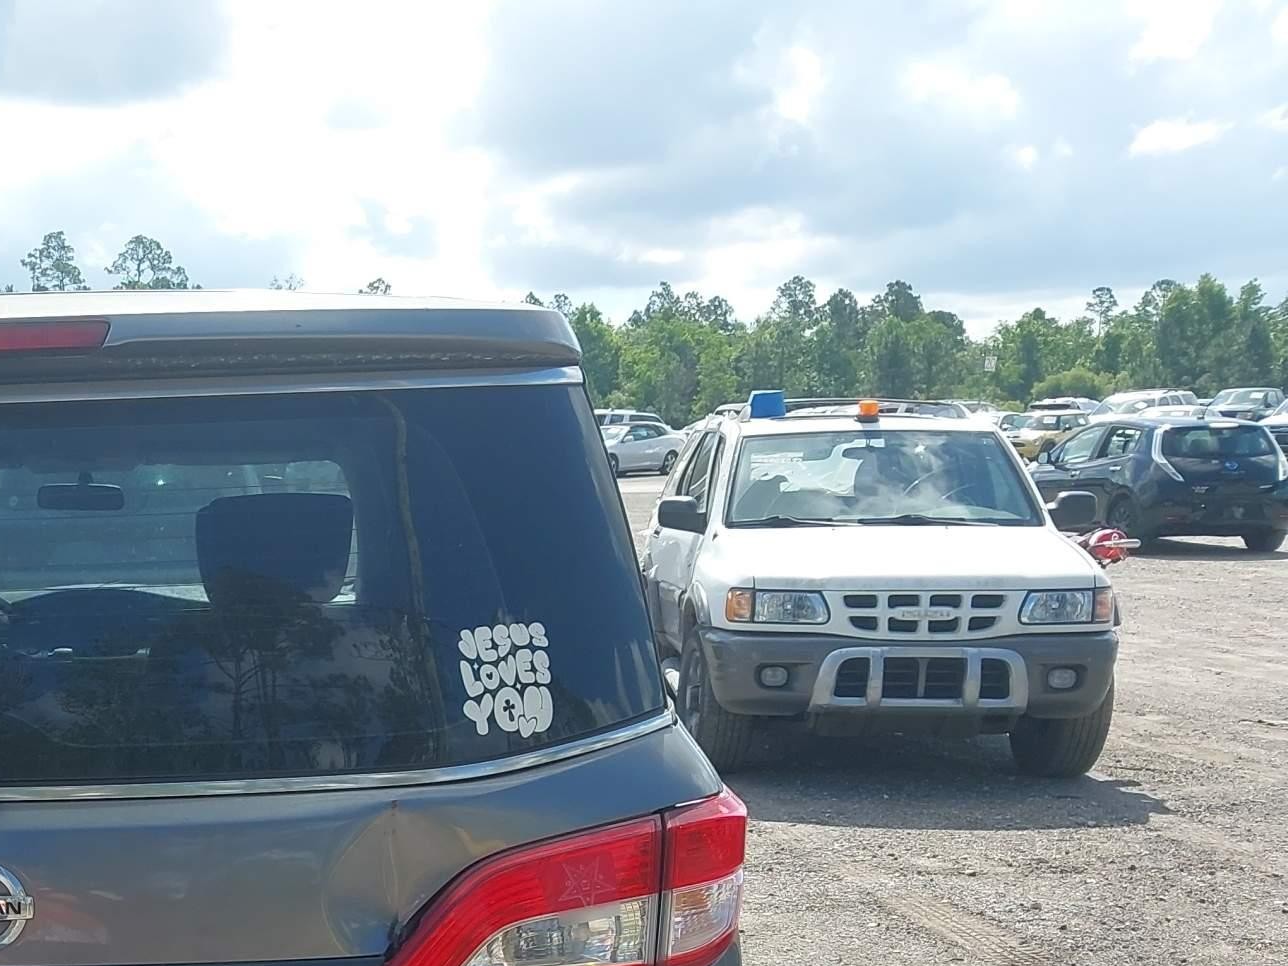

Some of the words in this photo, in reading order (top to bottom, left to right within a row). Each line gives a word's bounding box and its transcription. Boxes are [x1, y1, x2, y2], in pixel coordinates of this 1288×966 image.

[458, 622, 549, 662] JESUS
[459, 649, 552, 698] LOVES
[463, 685, 554, 736] YOU
